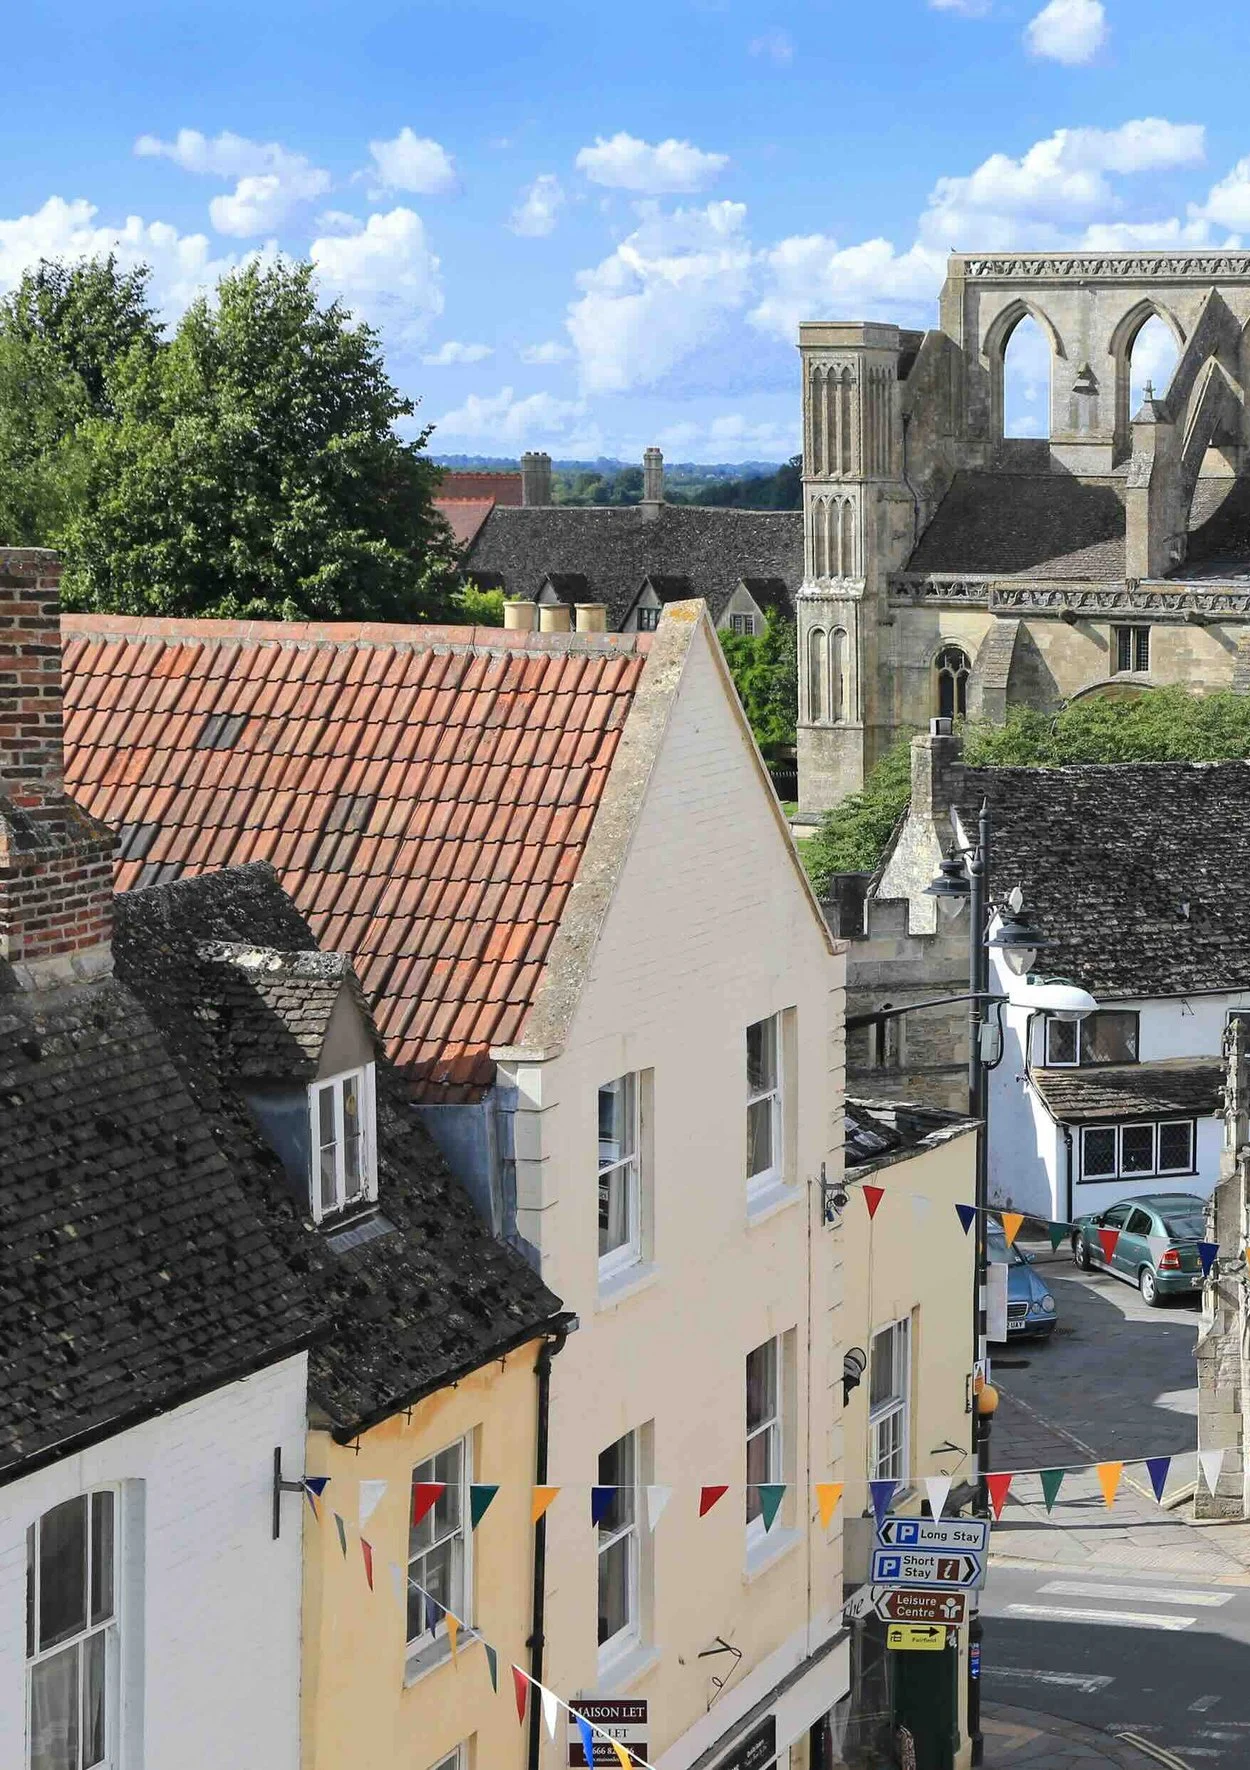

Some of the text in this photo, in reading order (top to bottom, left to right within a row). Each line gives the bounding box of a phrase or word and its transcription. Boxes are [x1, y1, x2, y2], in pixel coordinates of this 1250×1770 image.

[920, 1529, 948, 1542] Long
[953, 1531, 980, 1544] Stay
[903, 1555, 935, 1567] Short
[904, 1567, 931, 1579] Stay
[896, 1594, 937, 1606] Leisure
[896, 1606, 936, 1618] Centre
[622, 1706, 645, 1718] LET
[608, 1728, 629, 1738] LET
